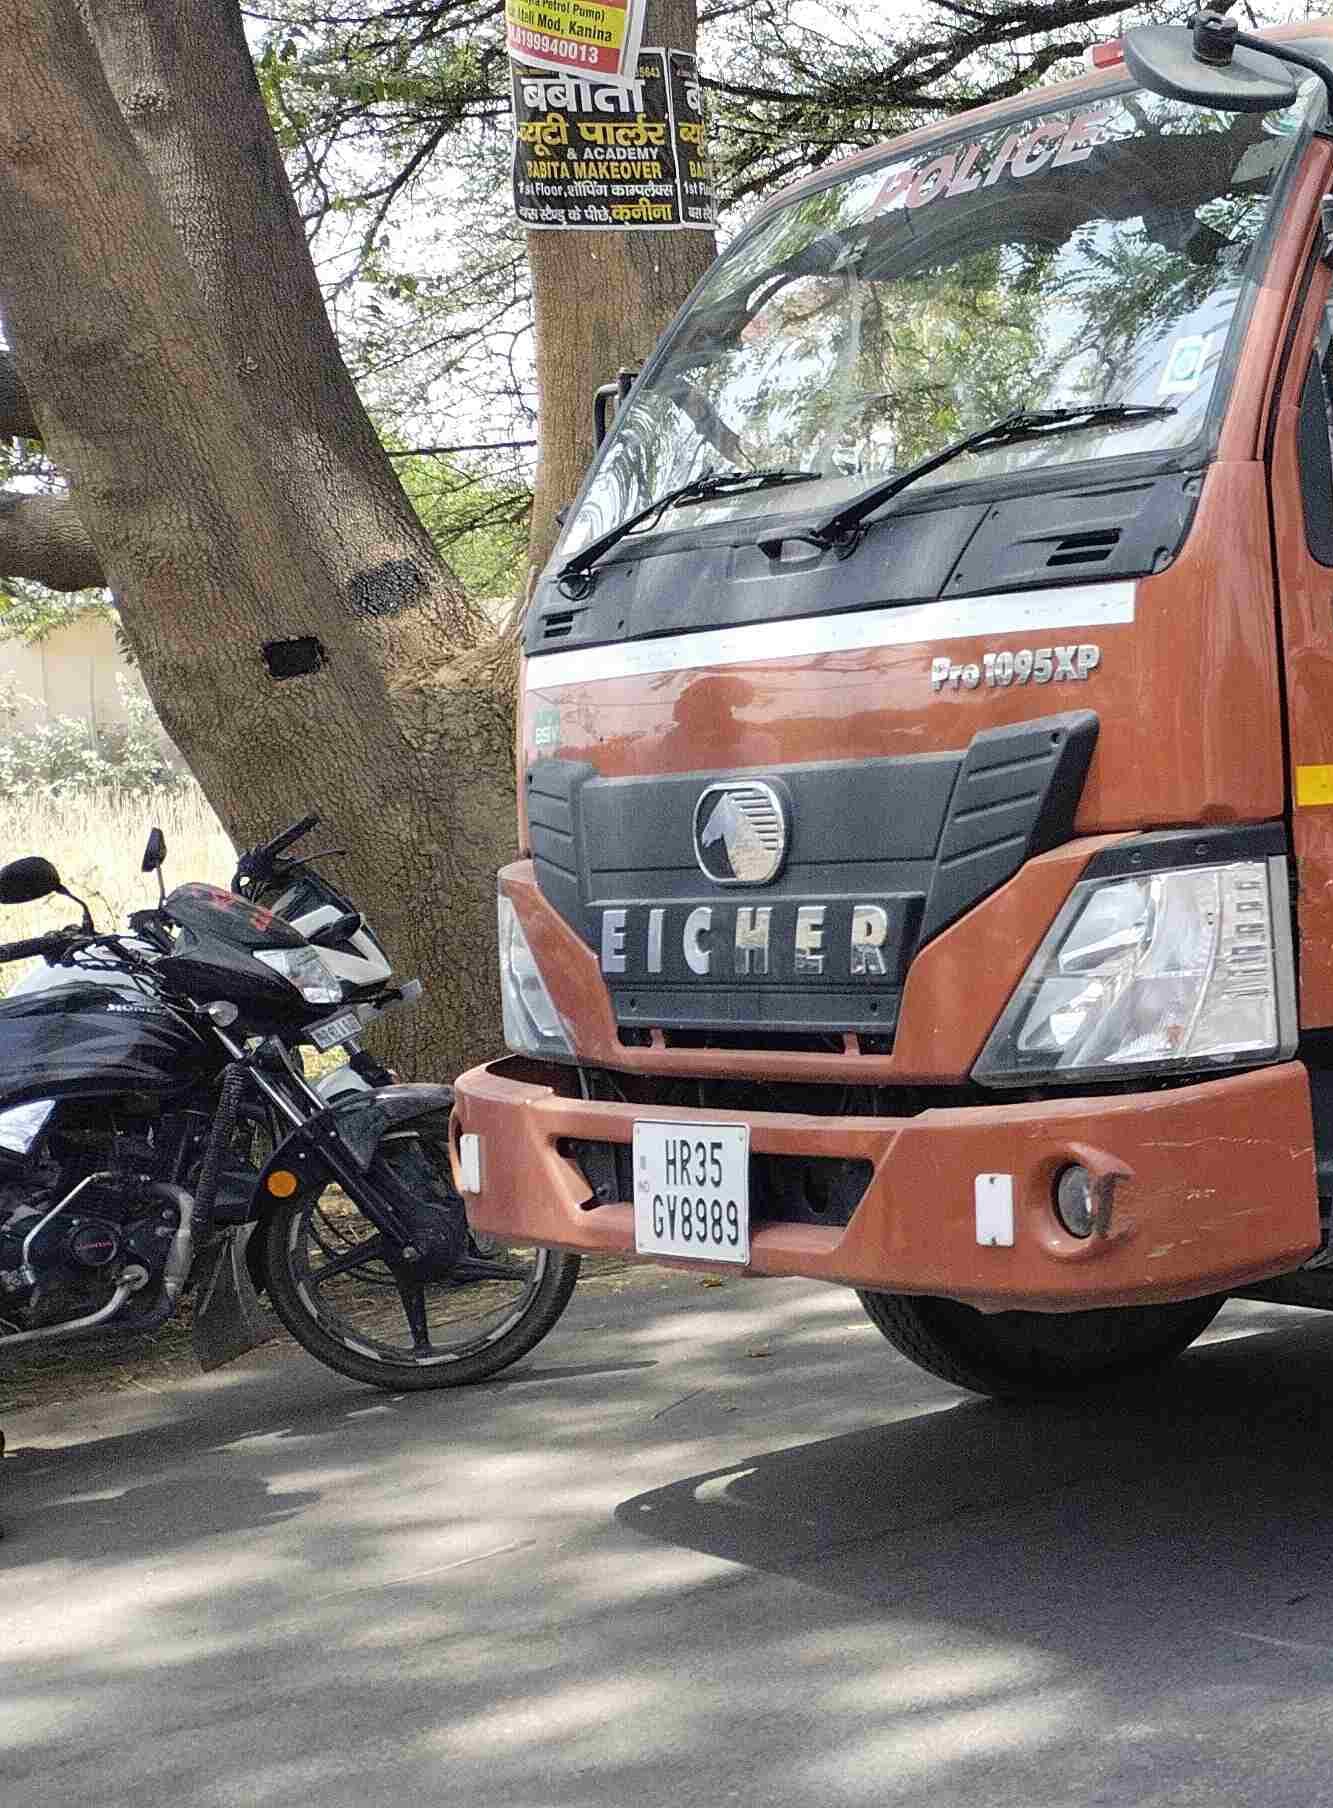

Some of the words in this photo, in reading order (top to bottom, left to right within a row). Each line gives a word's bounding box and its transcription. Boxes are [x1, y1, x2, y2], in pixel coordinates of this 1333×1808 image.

[568, 20, 612, 42] Kanina
[573, 4, 605, 23] Pump)
[577, 113, 667, 146] पार्लर
[527, 160, 570, 179] BABITA
[574, 161, 662, 179] MAKEOVER
[566, 148, 577, 160] &
[584, 147, 659, 160] ACADEMY
[865, 112, 1104, 220] POLICE
[931, 657, 980, 691] Pro
[983, 644, 1100, 687] 1095XP
[602, 905, 888, 976] EICHER
[665, 1139, 722, 1187] HR35
[653, 1194, 739, 1246] GV8989
